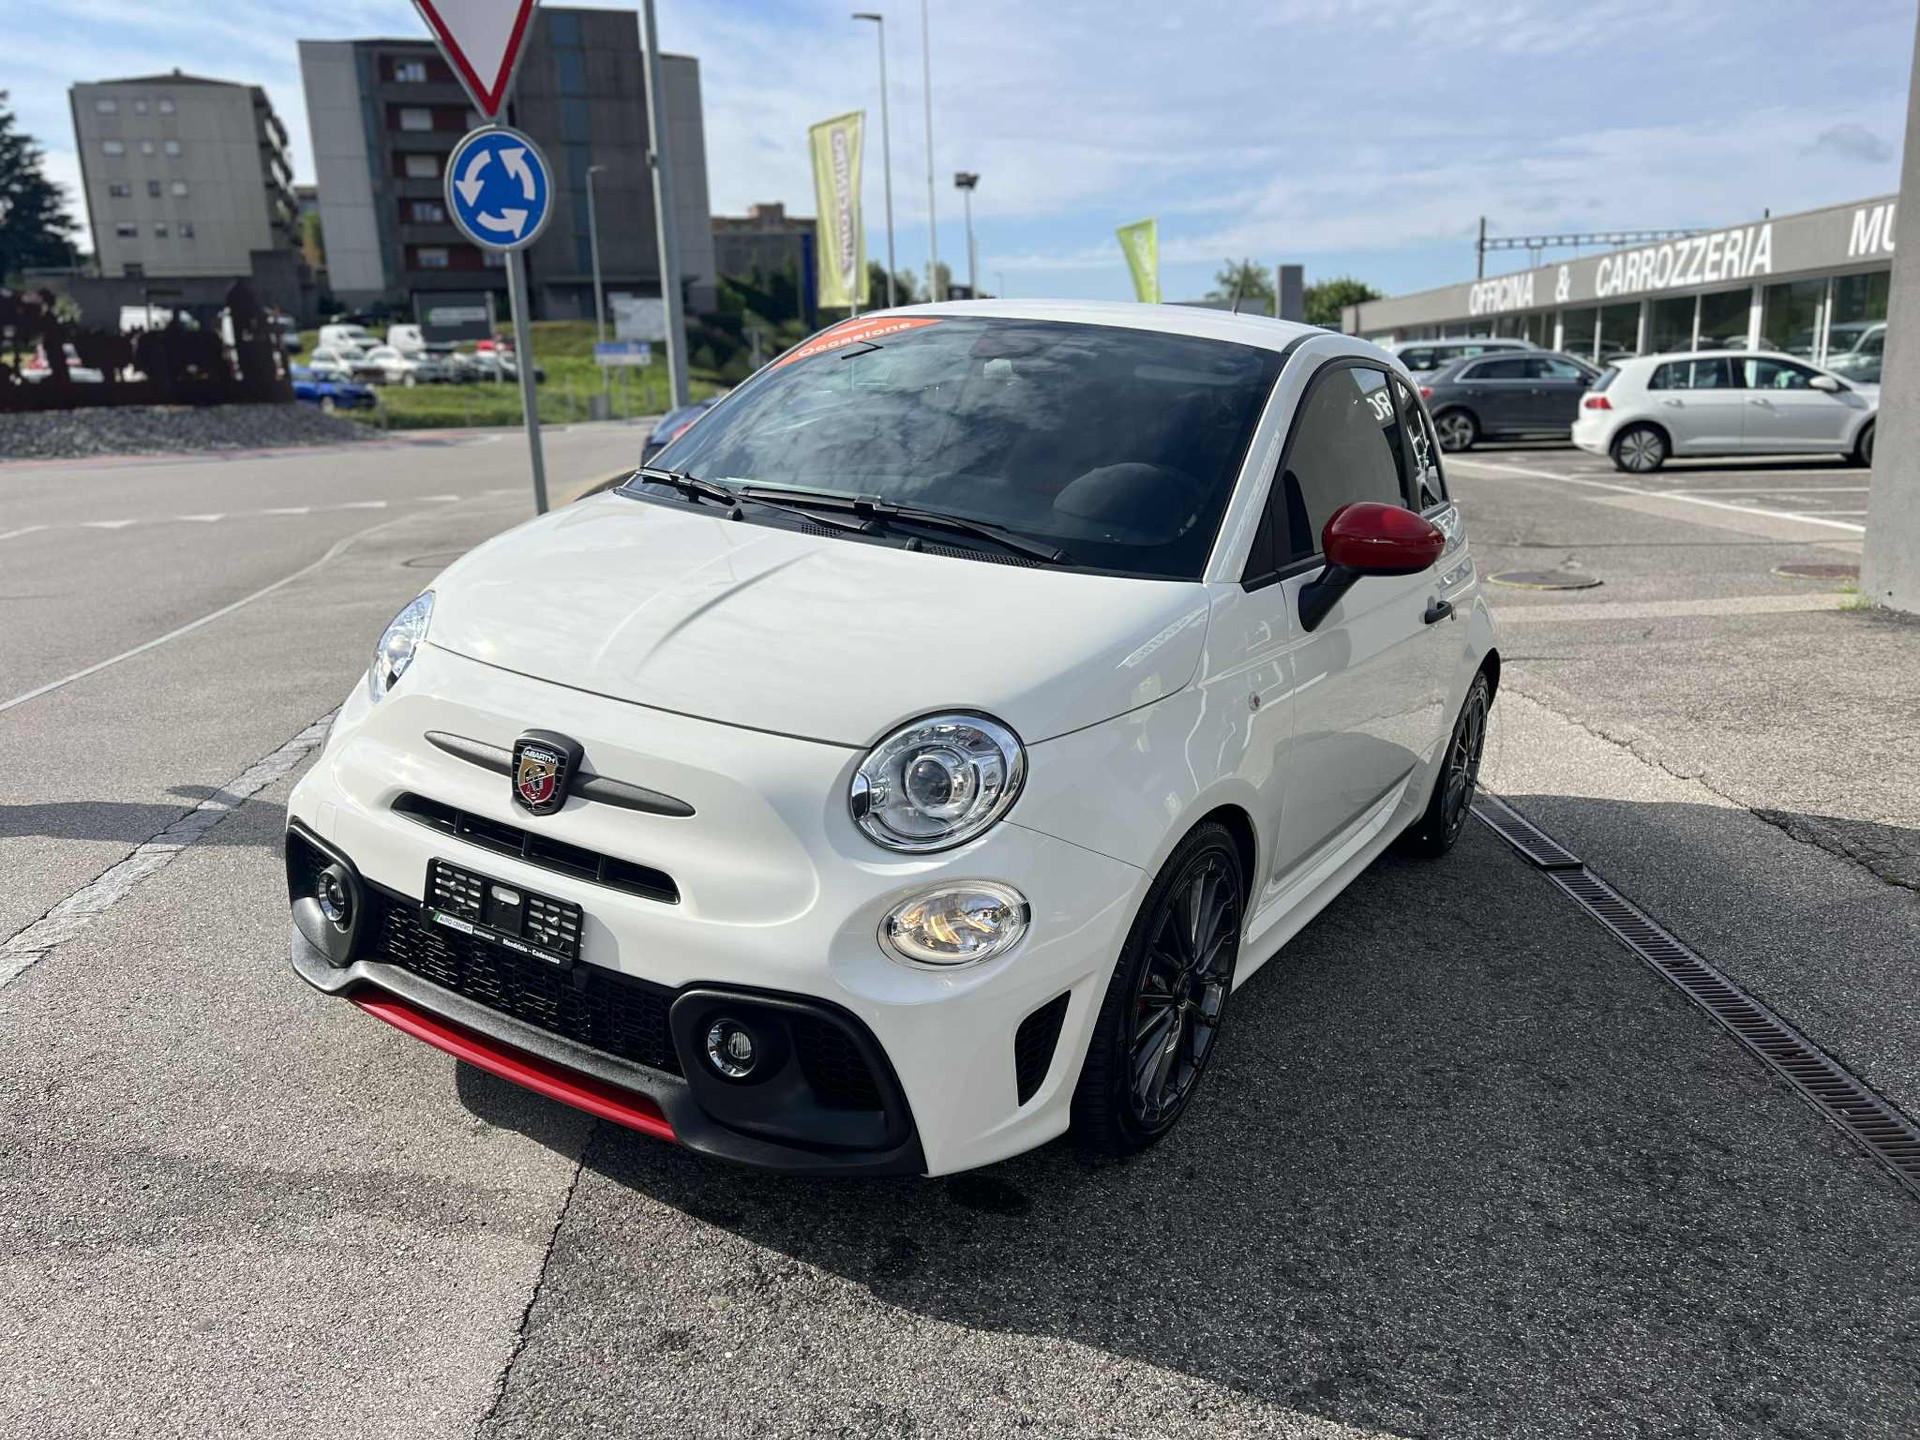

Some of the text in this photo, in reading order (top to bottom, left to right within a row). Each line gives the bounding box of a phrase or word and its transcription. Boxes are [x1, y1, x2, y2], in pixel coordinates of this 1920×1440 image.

[1469, 271, 1533, 316] OFFICINA
[1556, 264, 1571, 302] &
[1595, 223, 1773, 297] CARROZZERIA
[798, 322, 911, 357] Occasione
[524, 750, 556, 765] ABARTH
[438, 916, 453, 925] AUTO
[451, 920, 472, 932] CENTRO
